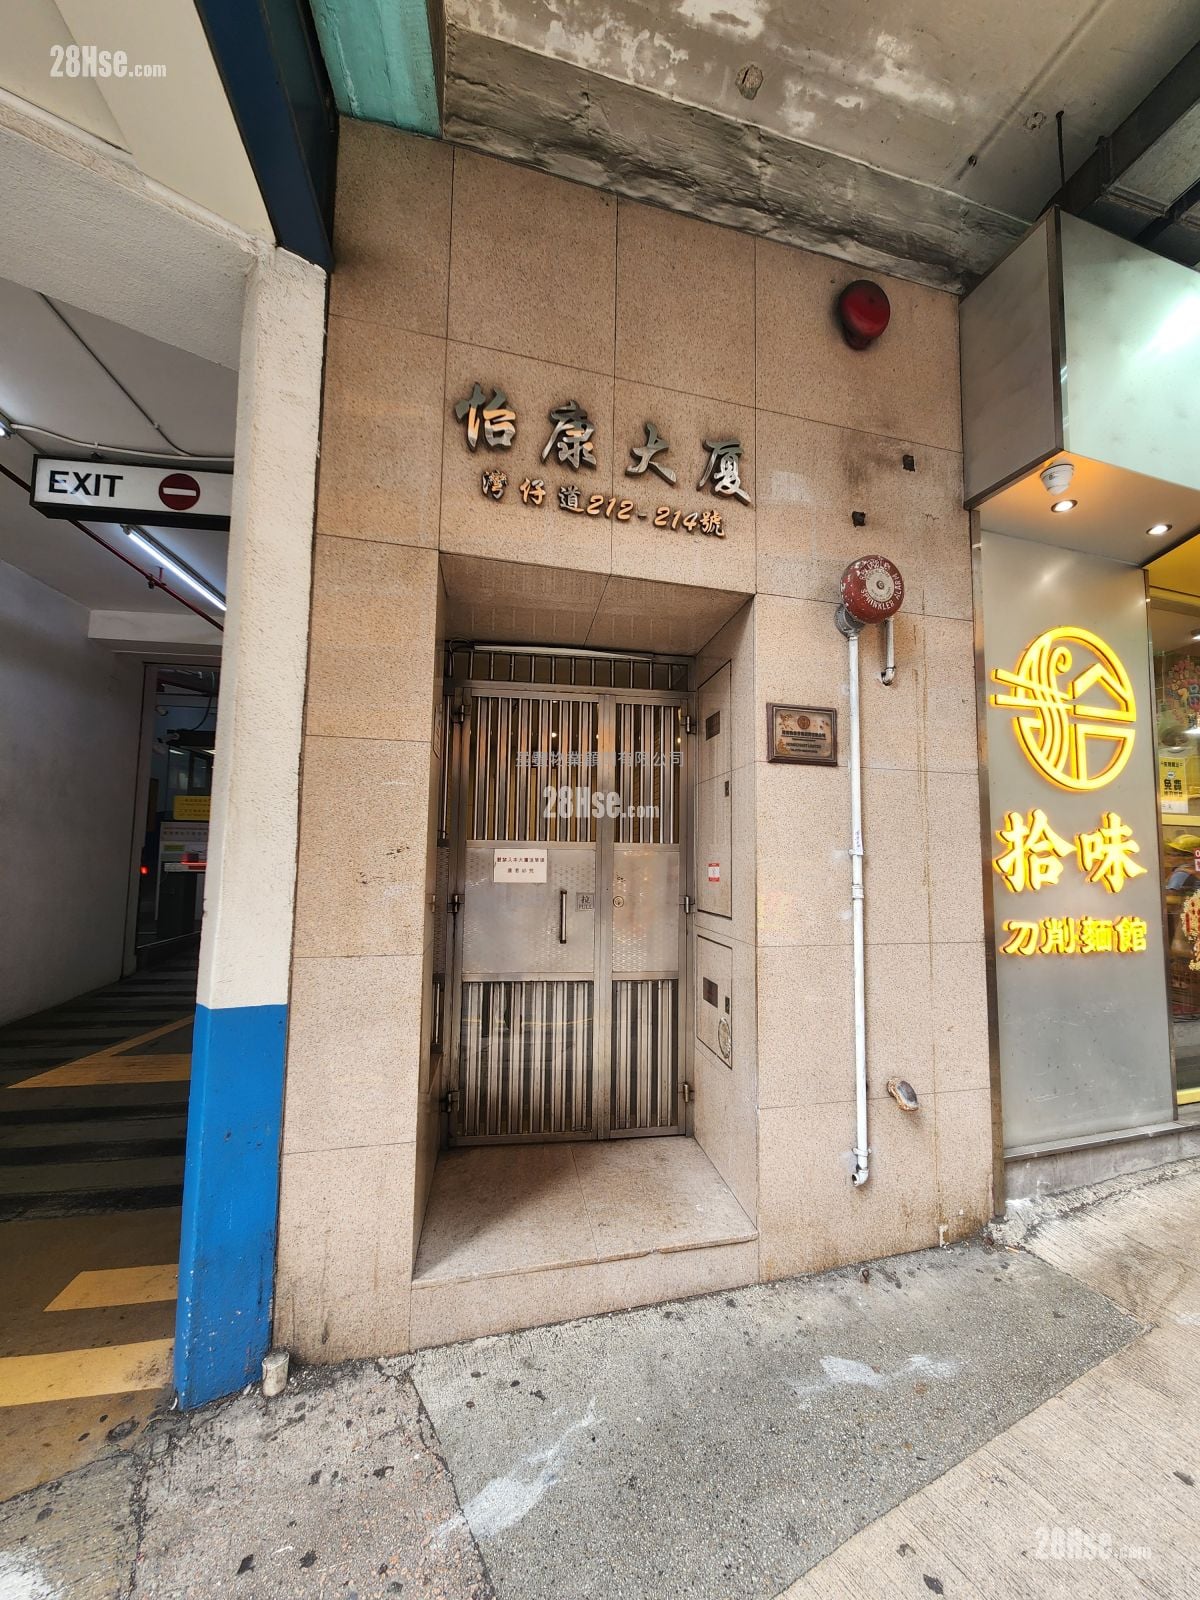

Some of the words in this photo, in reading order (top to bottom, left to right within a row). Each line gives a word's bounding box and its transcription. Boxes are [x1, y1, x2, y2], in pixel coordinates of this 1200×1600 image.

[455, 381, 752, 505] 怡康大廈
[48, 469, 123, 498] EXIT
[995, 809, 1148, 894] 拾味
[1001, 916, 1147, 956] 刀削麵館
